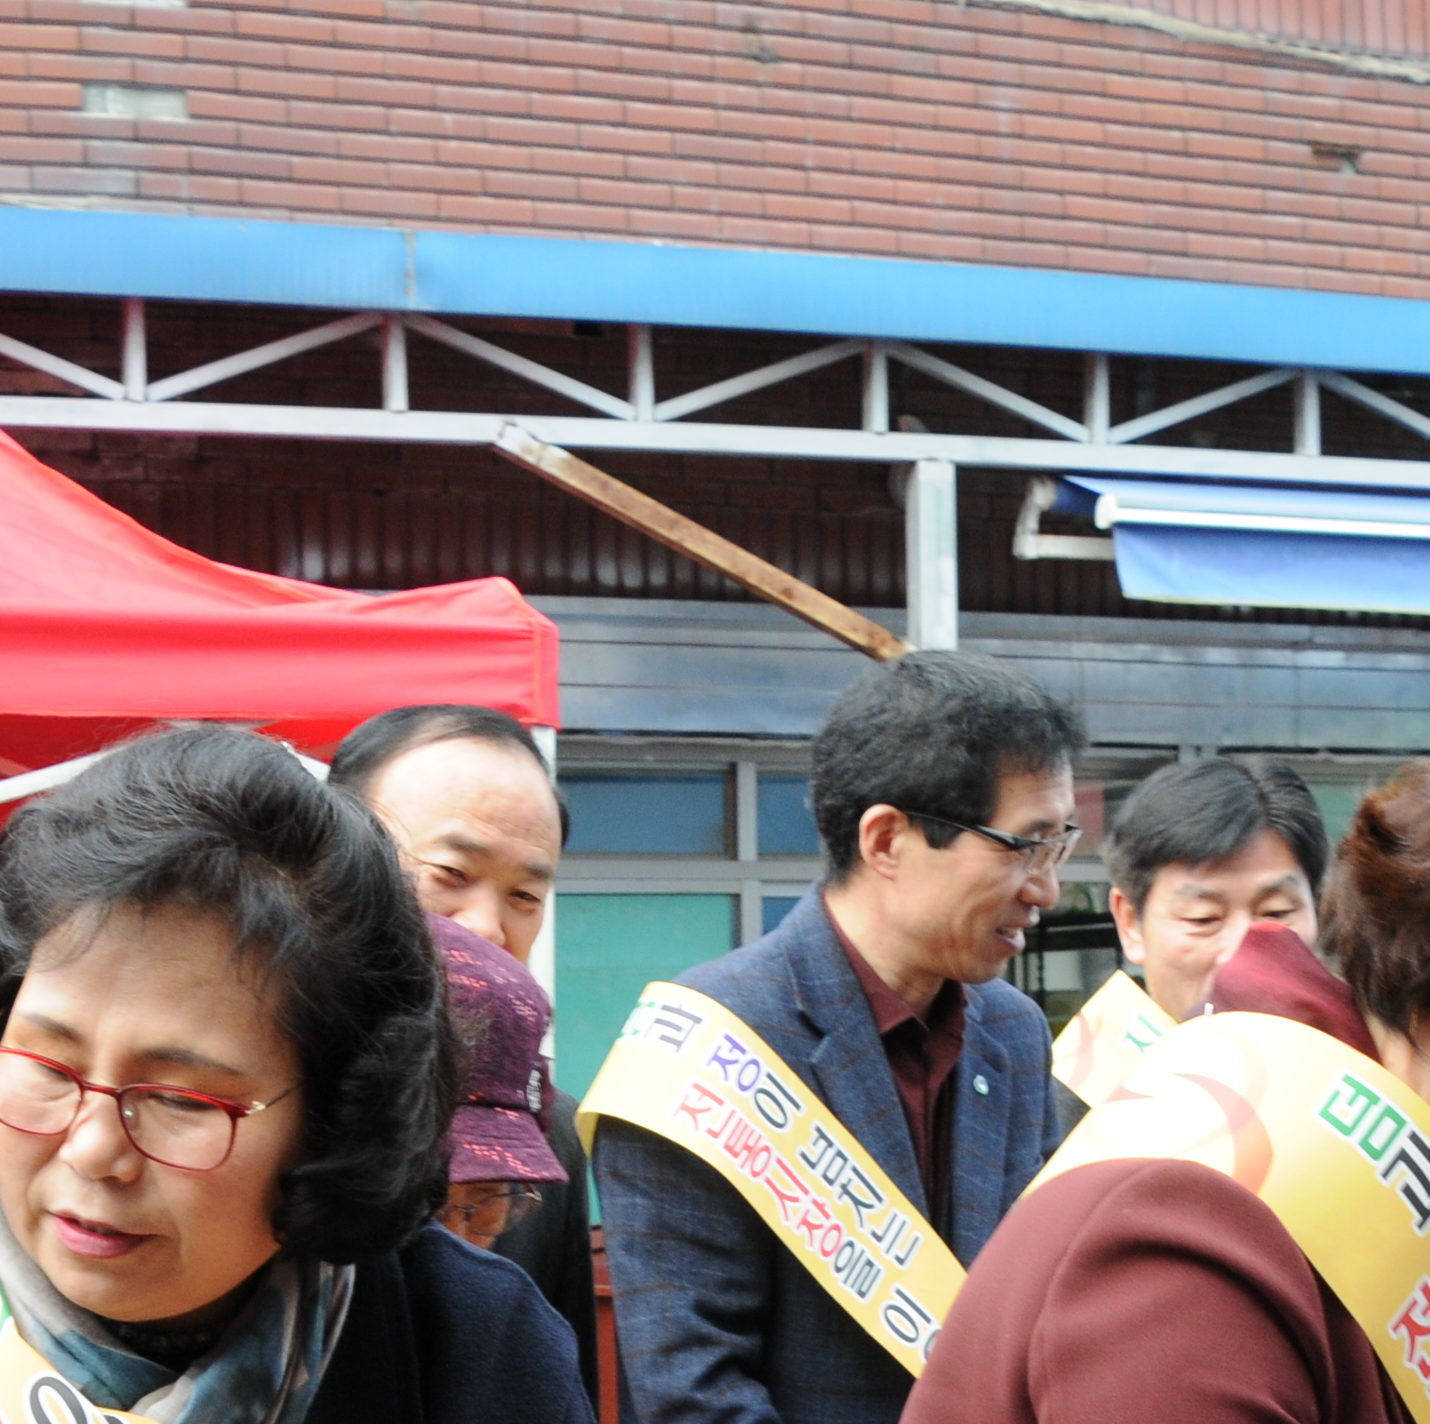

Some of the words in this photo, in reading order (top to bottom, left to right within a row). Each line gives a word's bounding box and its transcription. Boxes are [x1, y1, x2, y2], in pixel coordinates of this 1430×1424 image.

[673, 1082, 883, 1300] 전통시장을
[706, 1033, 802, 1129] 정이
[800, 1125, 920, 1266] 넘치는
